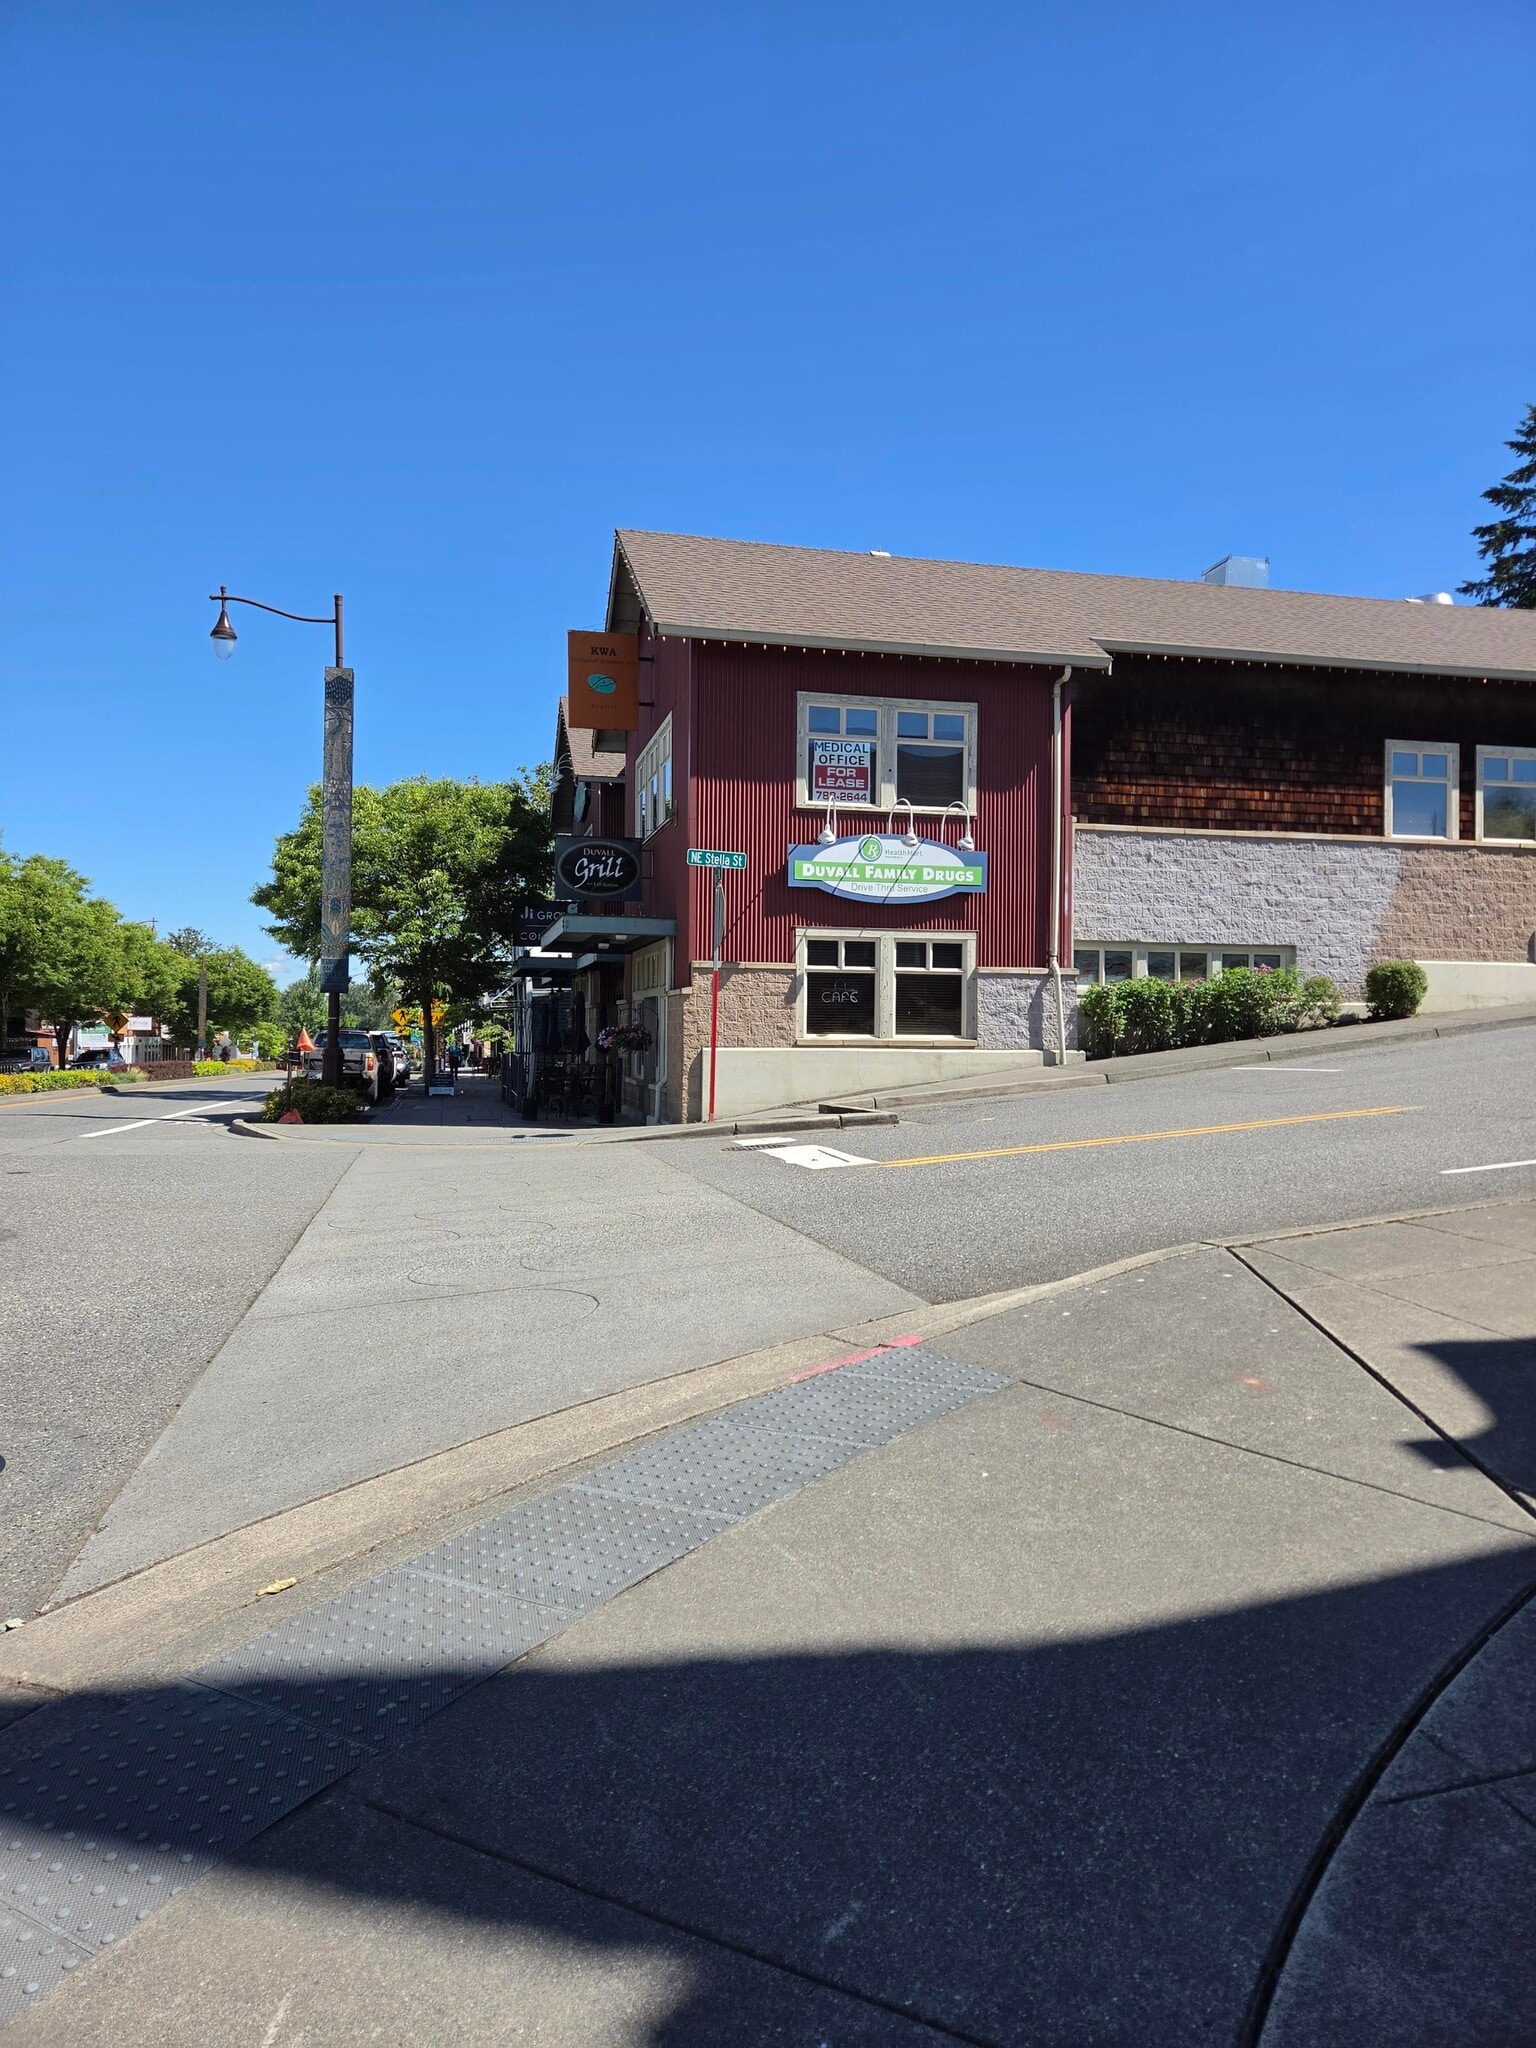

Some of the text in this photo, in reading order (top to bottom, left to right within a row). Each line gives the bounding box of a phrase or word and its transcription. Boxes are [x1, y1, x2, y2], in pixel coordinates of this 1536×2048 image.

[590, 646, 617, 657] KWA
[815, 742, 869, 753] MEDICAL
[819, 755, 865, 765] OFFICE
[827, 767, 856, 777] FOR
[818, 777, 865, 788] LEASE
[583, 847, 616, 856] DUVALL
[691, 851, 743, 866] NE Stella St
[574, 856, 623, 888] Grill
[802, 863, 974, 882] DUVALL FAMILY DRUGS
[852, 883, 873, 891] Drive
[897, 884, 928, 893] Service
[537, 911, 563, 920] GRO
